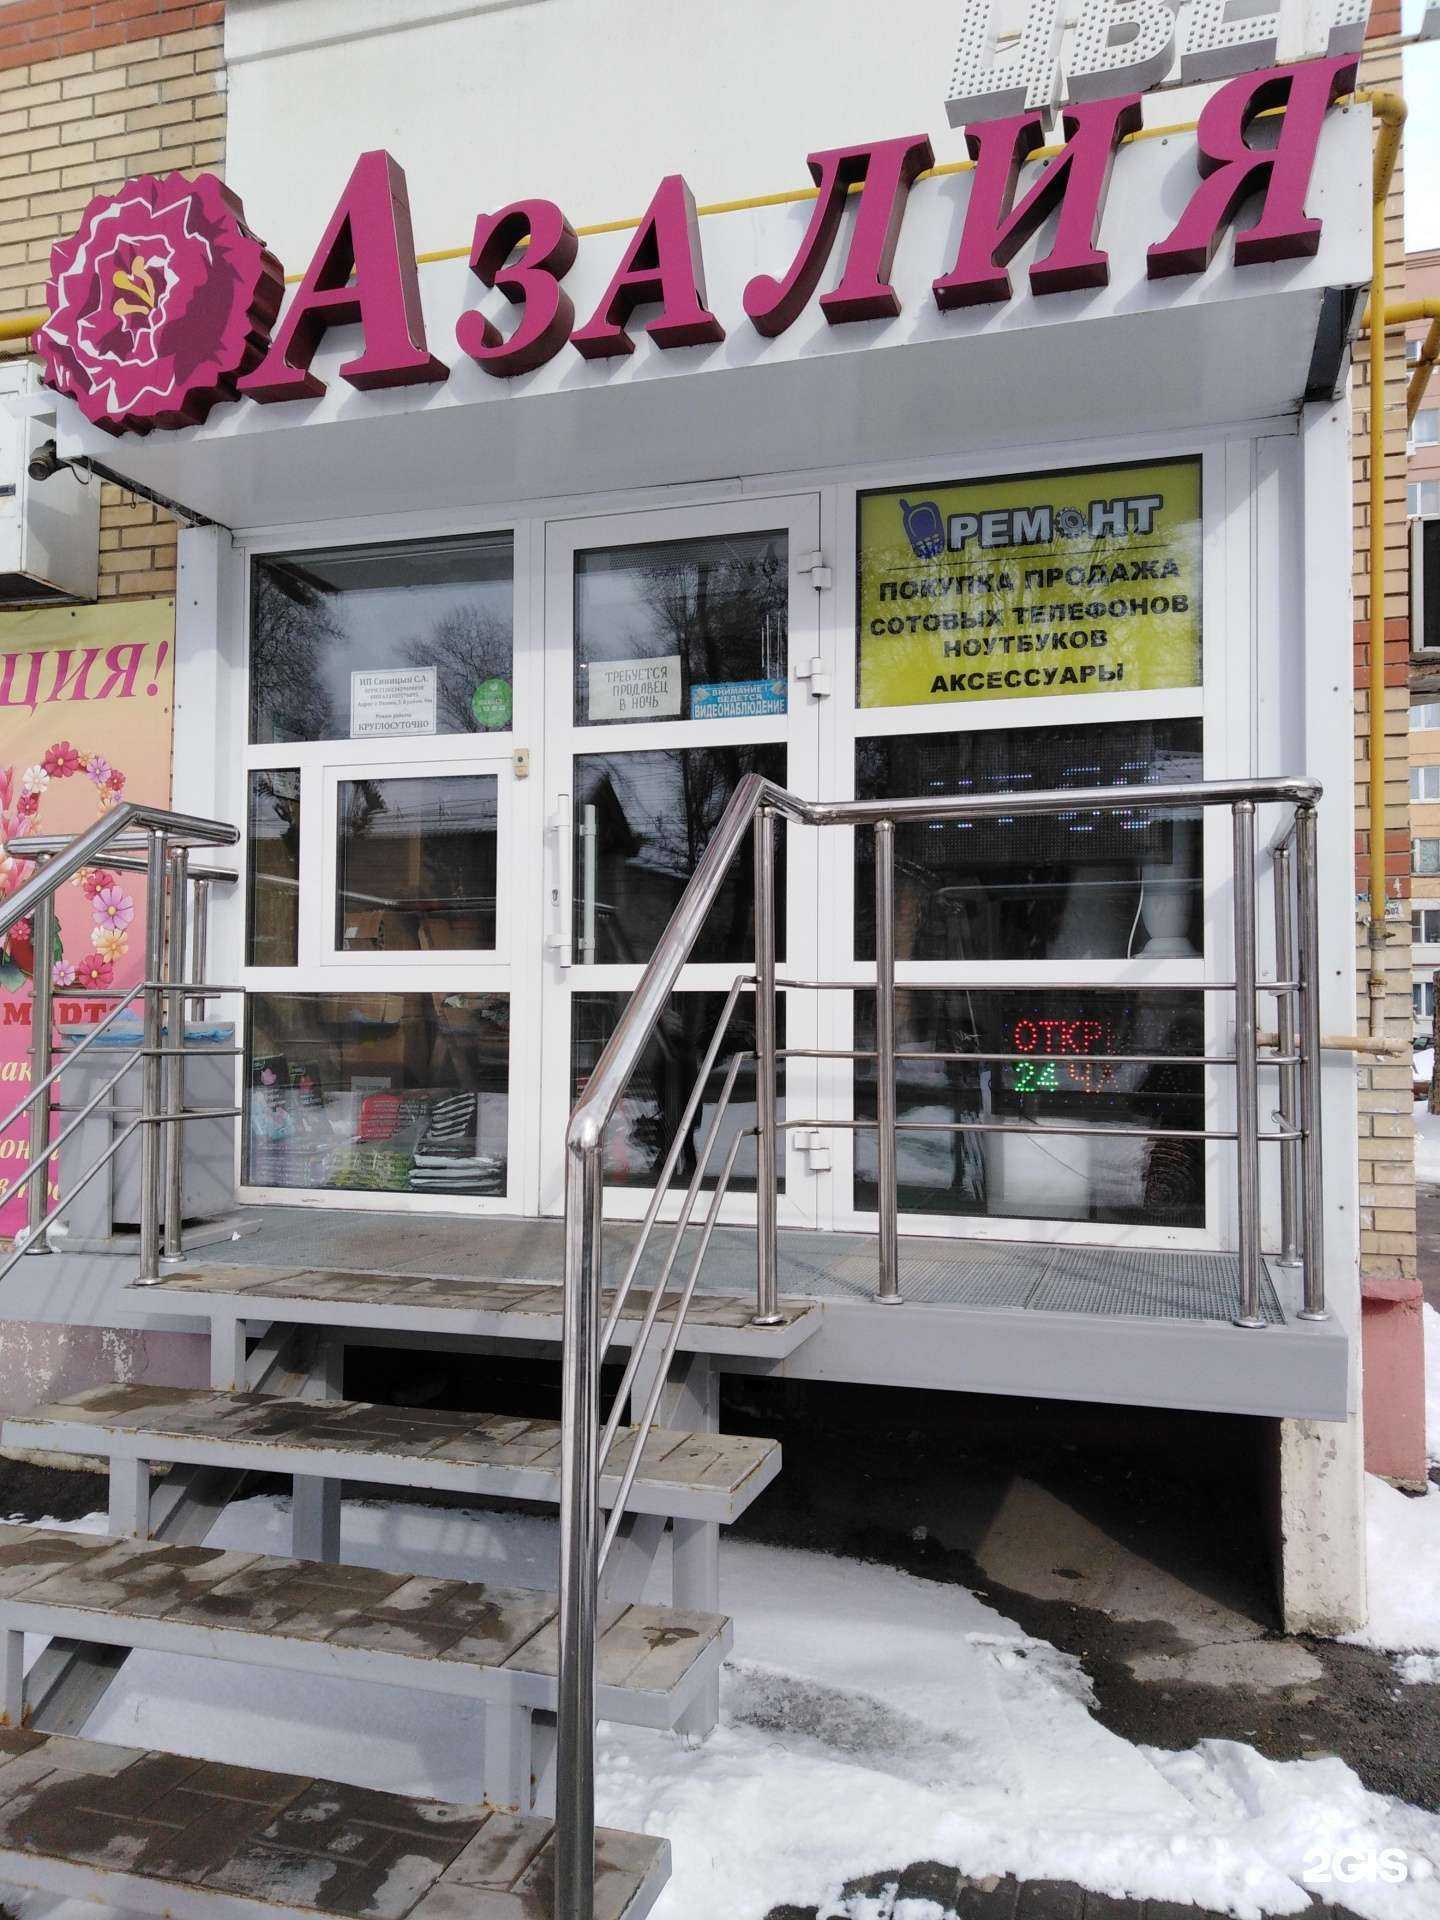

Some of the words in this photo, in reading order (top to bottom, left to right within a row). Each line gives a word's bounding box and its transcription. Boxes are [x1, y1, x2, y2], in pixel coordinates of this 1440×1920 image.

[238, 54, 1359, 404] АЗАЛИЯ
[947, 494, 1164, 552] РЕМОНТ
[879, 571, 1014, 601] ПОКУПКА
[1025, 558, 1181, 589] ПРОДАЖА
[870, 609, 1003, 636] СОТОВЫХ
[1012, 595, 1189, 625] ТЕЛЕФОНОВ
[943, 629, 1108, 658] НОУТБУКОВ
[0, 641, 168, 716] ЦИЯ!
[604, 665, 668, 682] ТРЕБУЕТСЯ
[613, 680, 668, 696] ПРОДАВЕЦ
[930, 663, 1124, 693] АКСЕССУАРЫ
[619, 698, 626, 711] В
[632, 695, 659, 709] НОЧЬ
[694, 699, 785, 718] ВИДЕОНАБЛЮДЕНИЕ
[359, 720, 429, 731] КРУГЛОСУТОЧНО
[1014, 1062, 1059, 1092] 24
